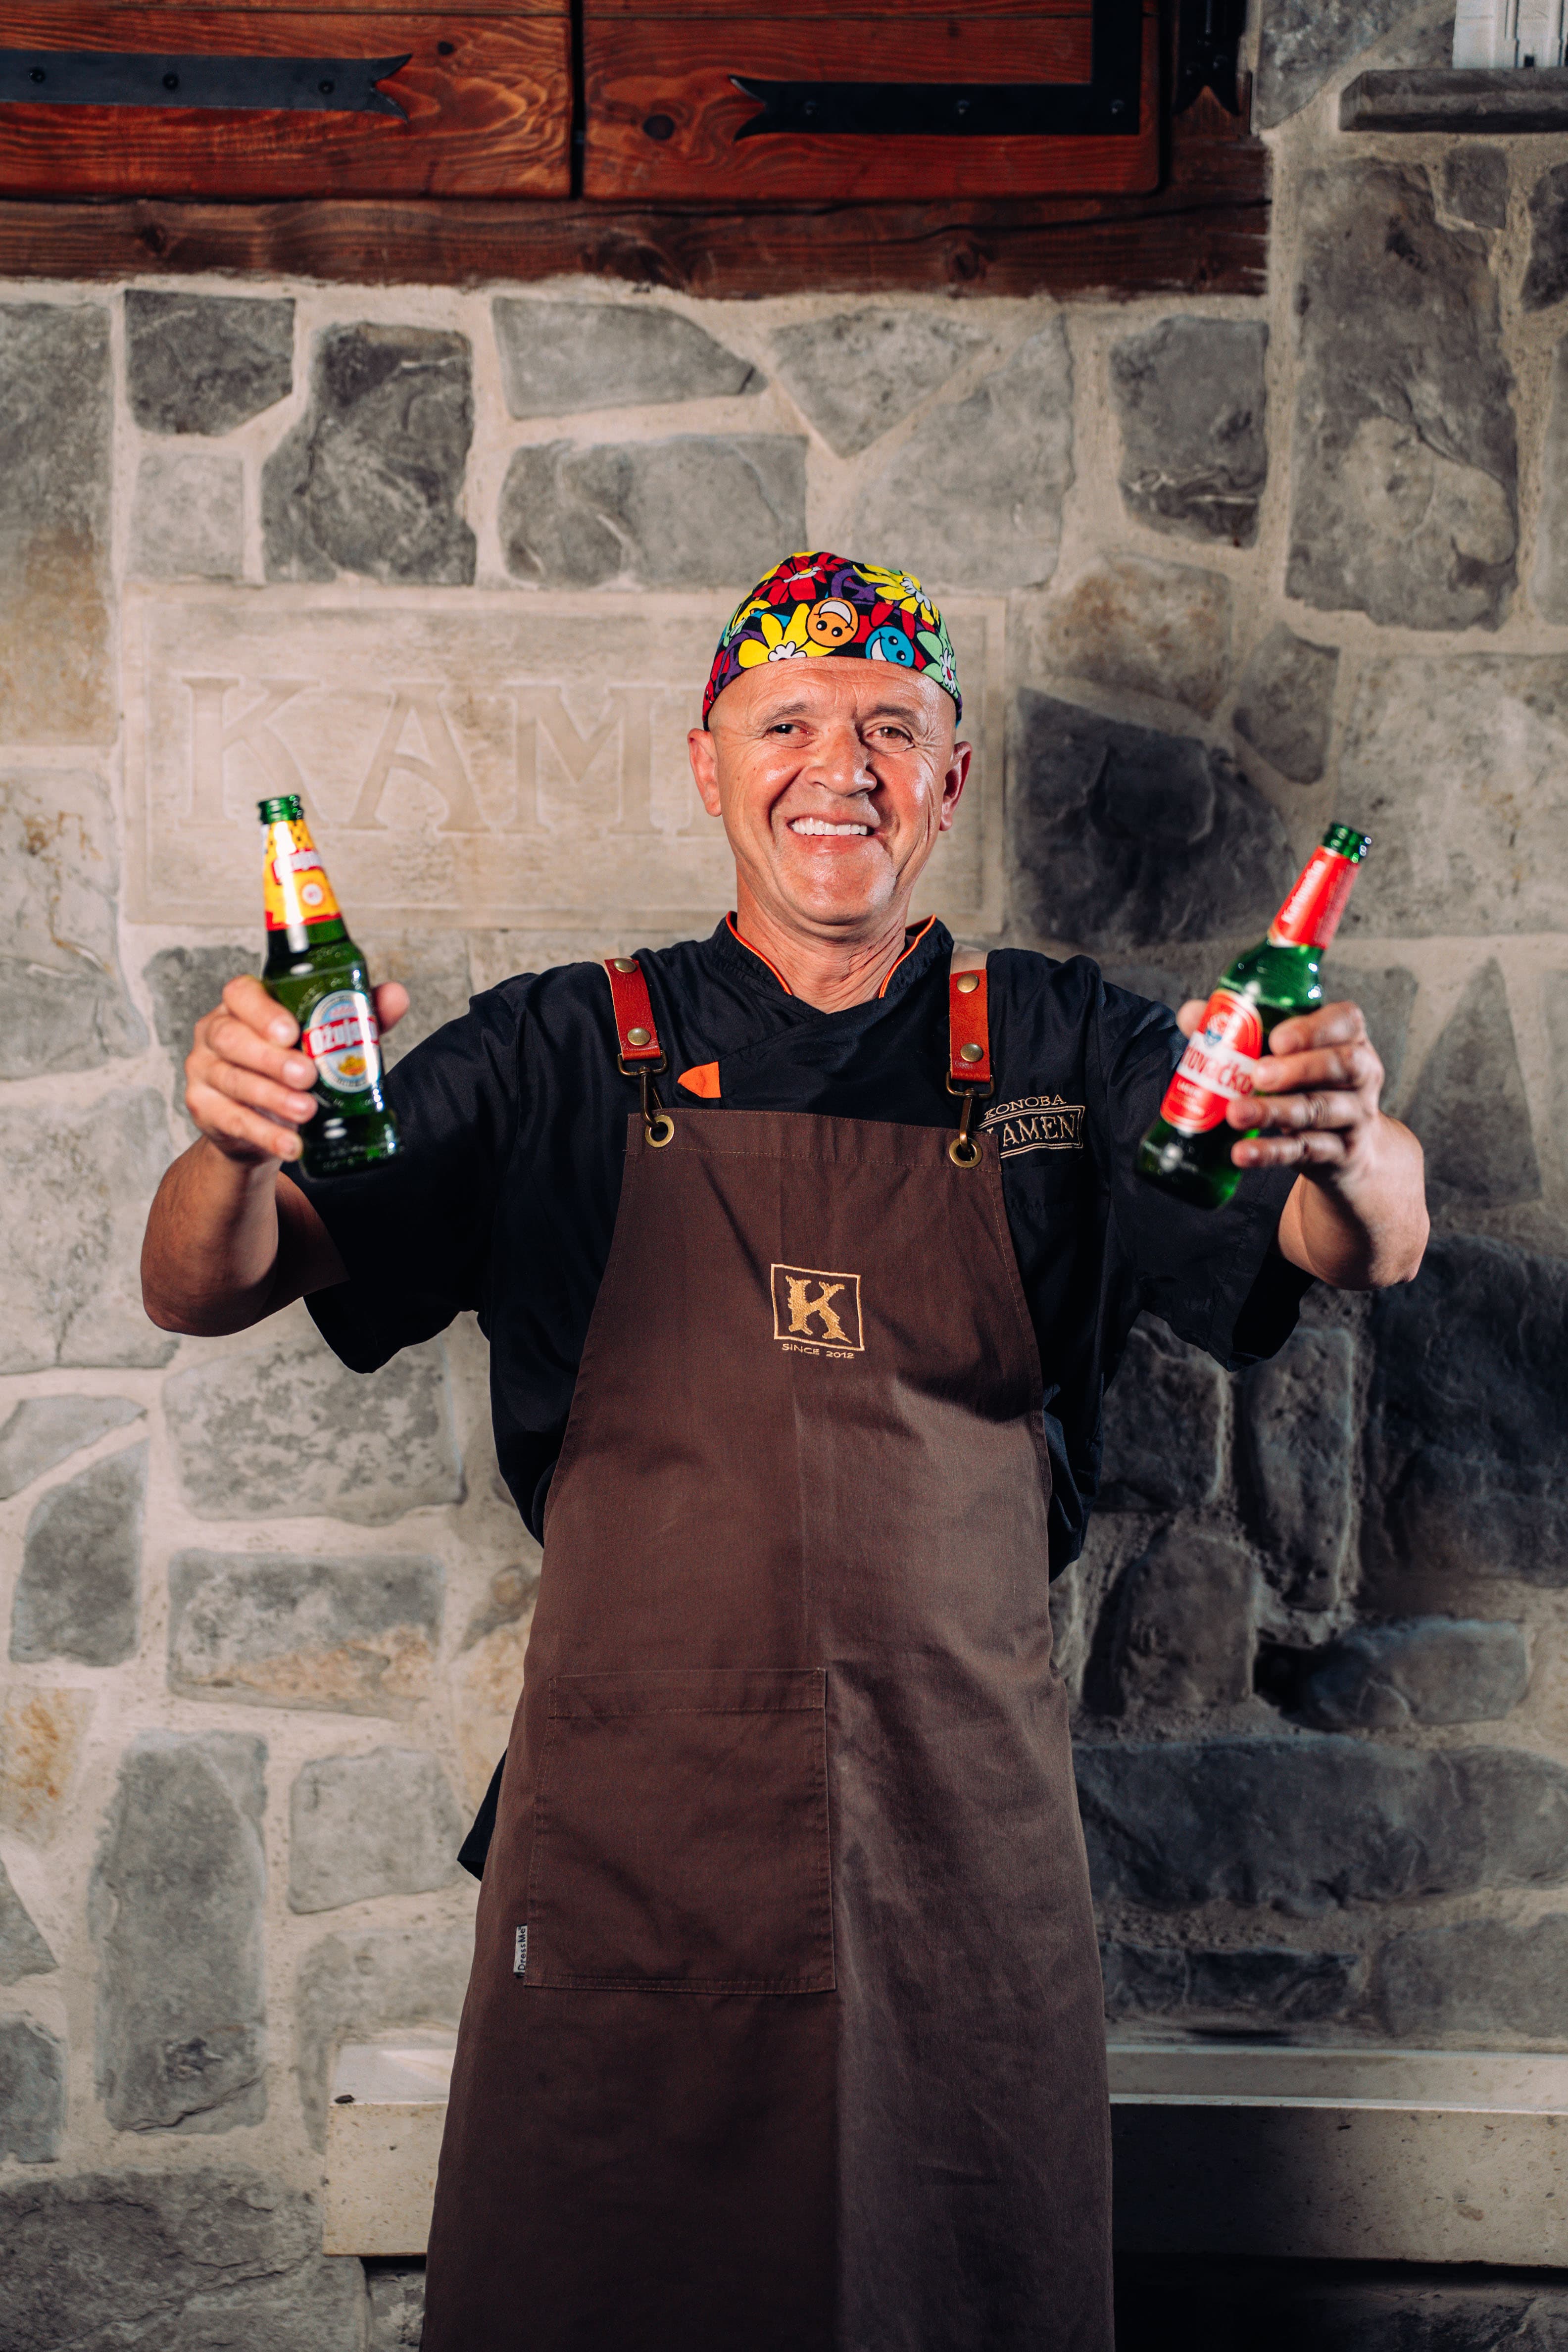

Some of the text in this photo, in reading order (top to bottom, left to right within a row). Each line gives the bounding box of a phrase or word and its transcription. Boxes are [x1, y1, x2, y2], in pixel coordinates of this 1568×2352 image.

[176, 676, 730, 836] KAM
[984, 1094, 1067, 1121] KONOBA
[986, 1114, 1078, 1147] AMEN
[785, 1274, 852, 1344] K
[782, 1343, 855, 1359] SINCE 2012
